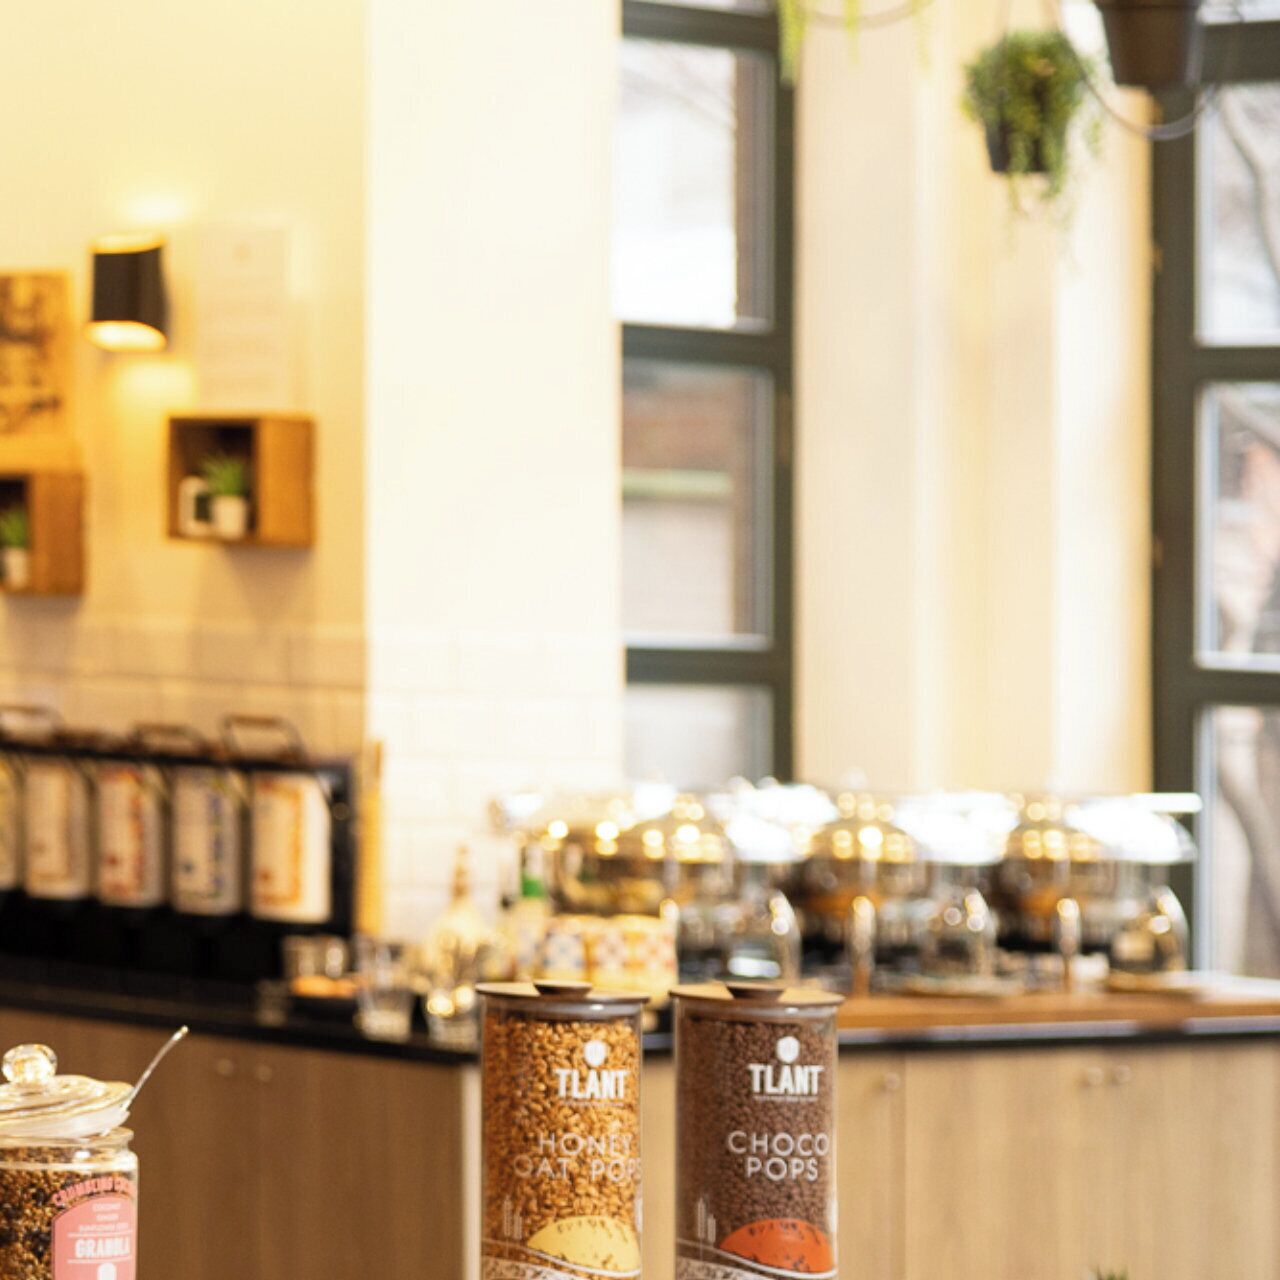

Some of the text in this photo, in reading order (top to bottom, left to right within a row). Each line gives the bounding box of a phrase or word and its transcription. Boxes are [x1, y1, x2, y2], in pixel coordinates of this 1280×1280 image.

[555, 1069, 629, 1100] TLANT
[748, 1064, 825, 1095] TLANT
[538, 1132, 632, 1156] HONEY
[727, 1131, 829, 1156] CHOCO
[513, 1157, 571, 1179] OAT
[746, 1157, 819, 1182] POPS
[75, 1236, 131, 1259] GRANOLA
